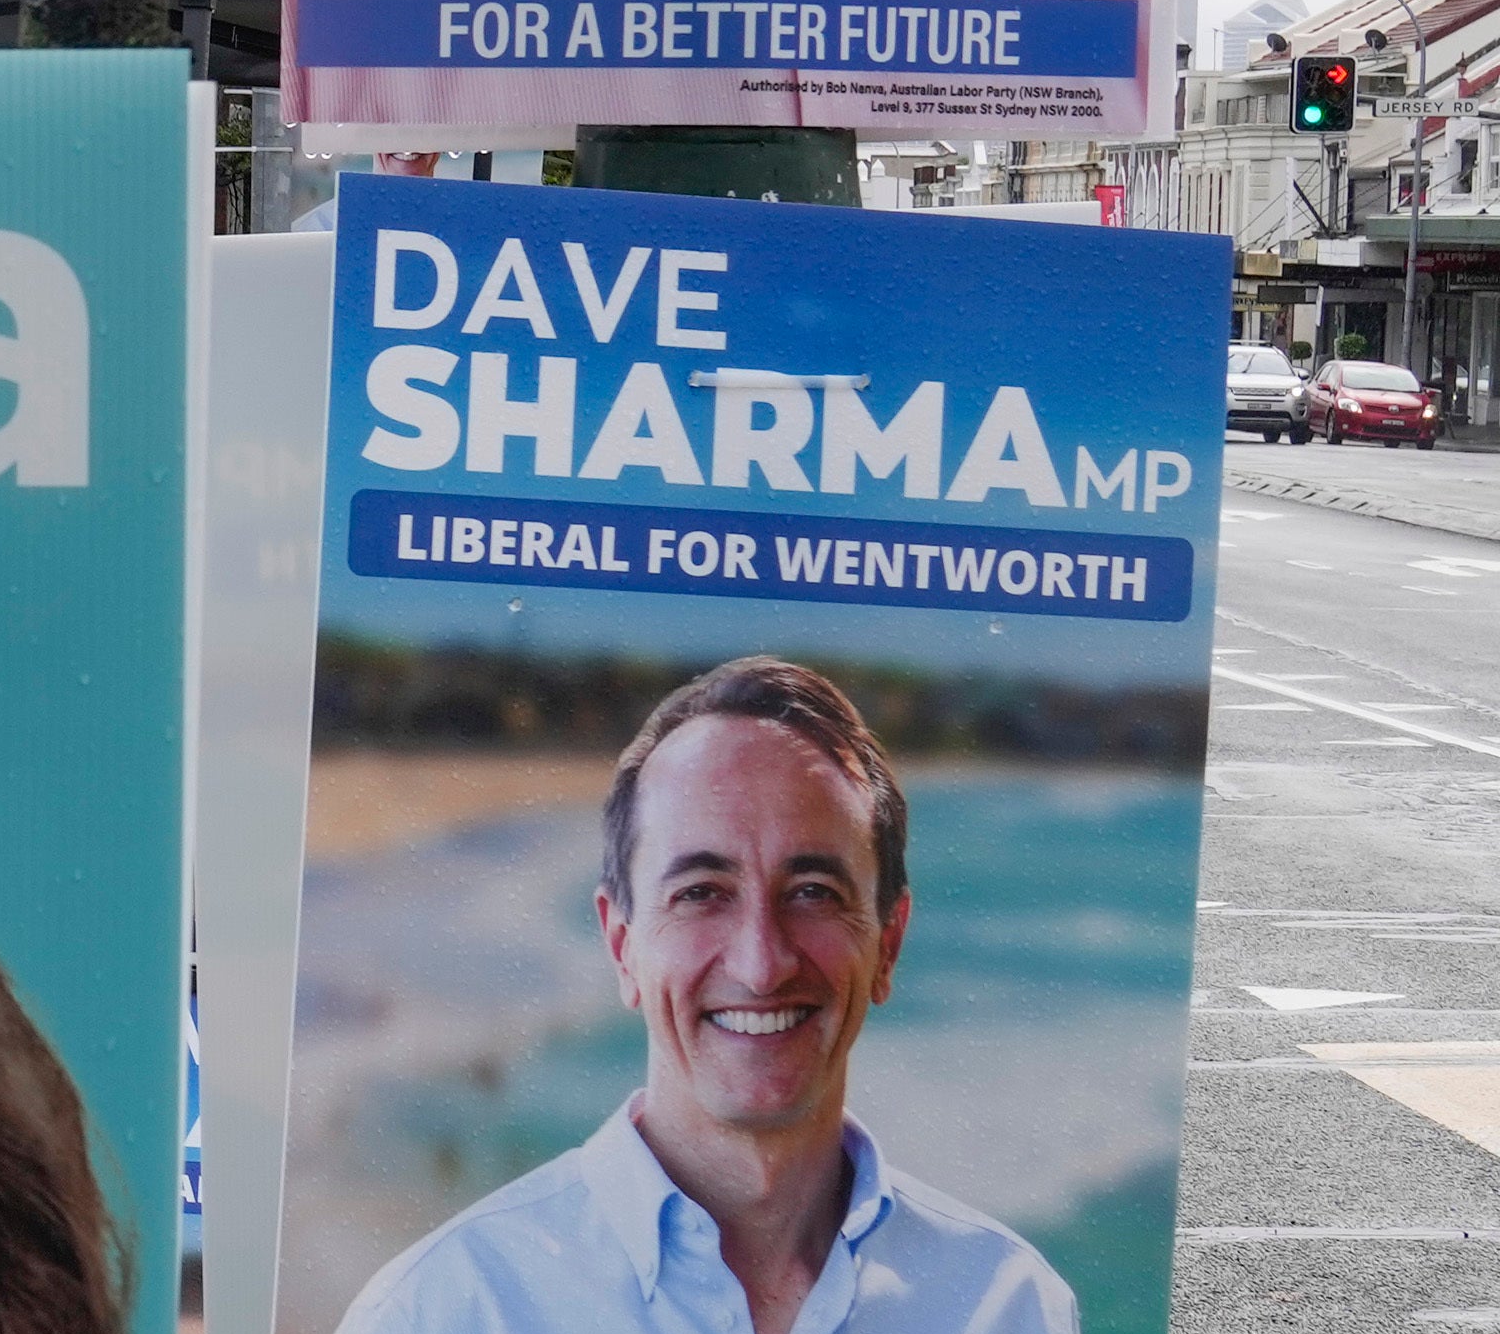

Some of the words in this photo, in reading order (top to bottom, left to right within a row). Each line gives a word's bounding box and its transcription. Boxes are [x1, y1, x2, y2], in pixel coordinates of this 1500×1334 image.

[438, 2, 551, 60] FOR
[565, 4, 604, 59] A
[622, 3, 826, 62] BETTER
[840, 6, 1022, 67] FUTURE
[740, 79, 808, 92] Authorised
[810, 82, 824, 95] by
[826, 82, 847, 93] Bob
[850, 83, 887, 96] Nanva,
[890, 83, 946, 96] Australian
[950, 85, 982, 97] Labor
[986, 86, 1016, 101] Party
[1019, 86, 1053, 100] (NSW
[1055, 87, 1103, 101] Branch),
[871, 101, 900, 113] Level
[903, 103, 912, 114] 9,
[915, 102, 935, 114] 377
[937, 103, 976, 115] Sussex
[980, 103, 991, 115] St
[995, 104, 1037, 118] Sydney
[1040, 105, 1068, 117] NSW
[1071, 105, 1103, 117] 2000.
[1382, 101, 1444, 113] JERSEY
[1453, 101, 1474, 112] RD
[374, 227, 727, 350] DAVE
[361, 345, 1068, 509] SHARMA
[1074, 447, 1191, 513] MP
[397, 513, 628, 575] LIBERAL
[648, 527, 757, 580] FOR
[774, 532, 1147, 604] WENTWORTH
